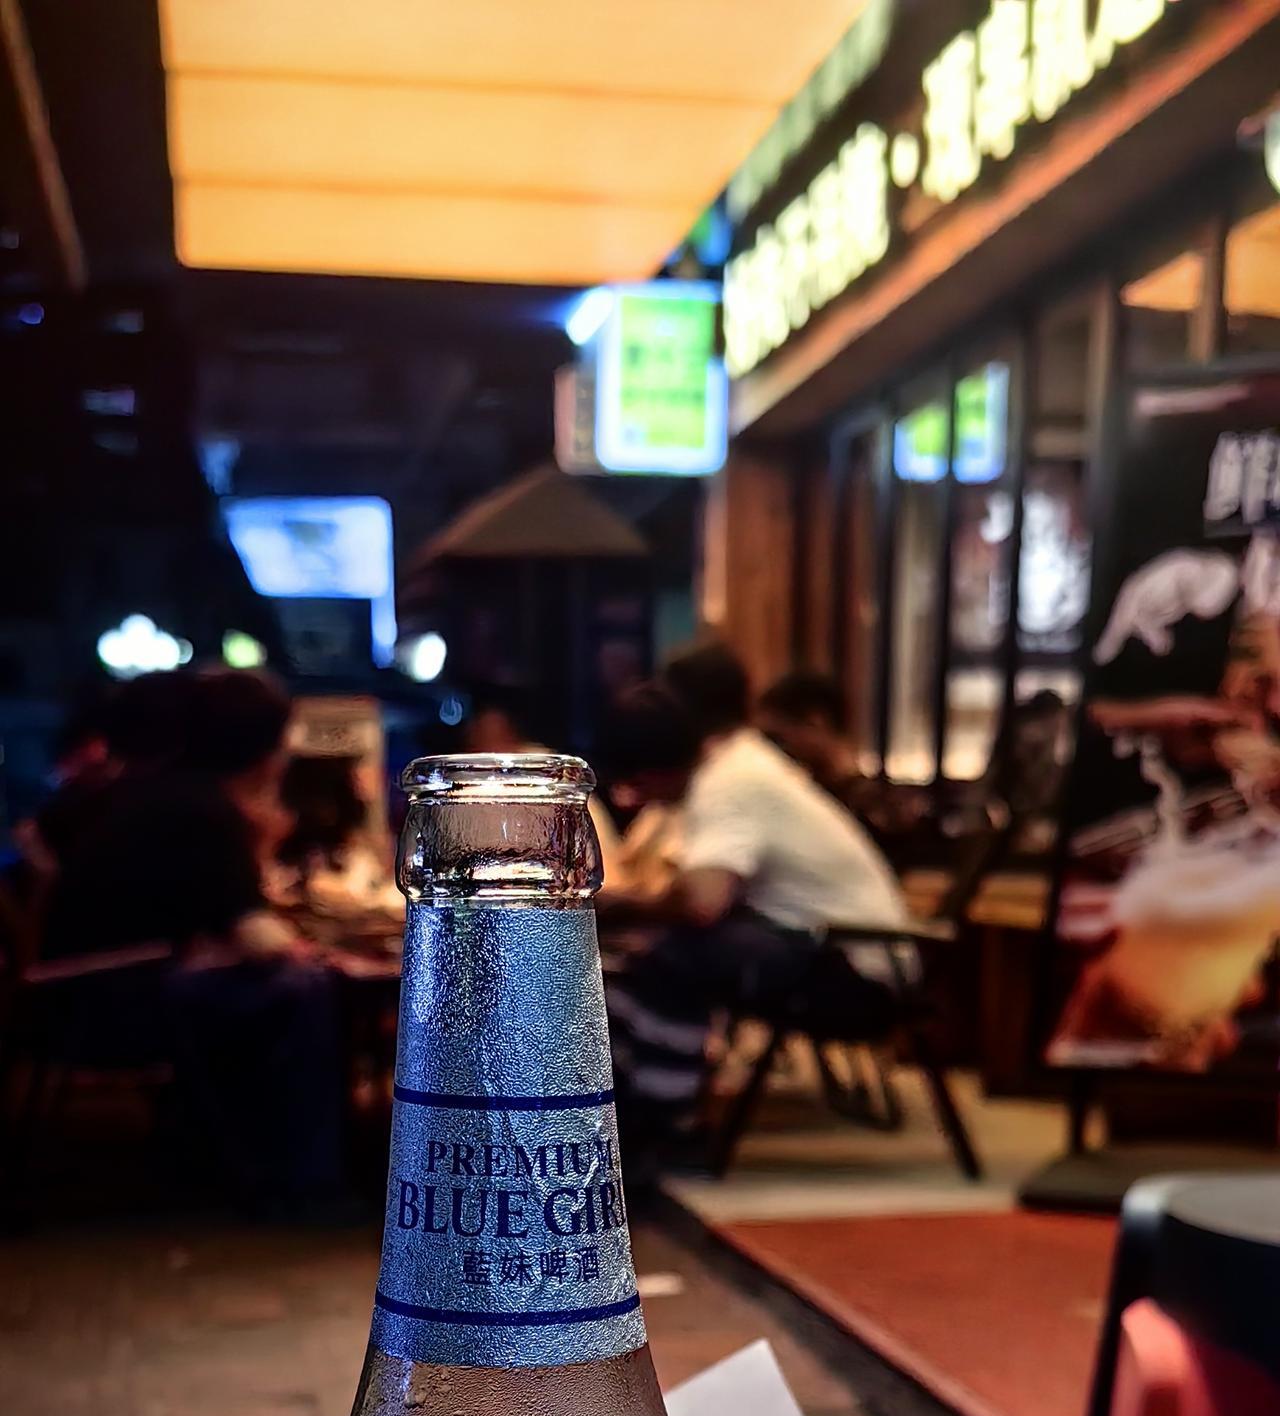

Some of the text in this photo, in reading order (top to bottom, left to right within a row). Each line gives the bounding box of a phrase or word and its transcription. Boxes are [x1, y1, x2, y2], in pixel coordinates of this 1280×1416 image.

[425, 1138, 614, 1177] PREMIUM
[398, 1180, 530, 1239] BLUE
[462, 1248, 600, 1286] 藍妹啤酒
